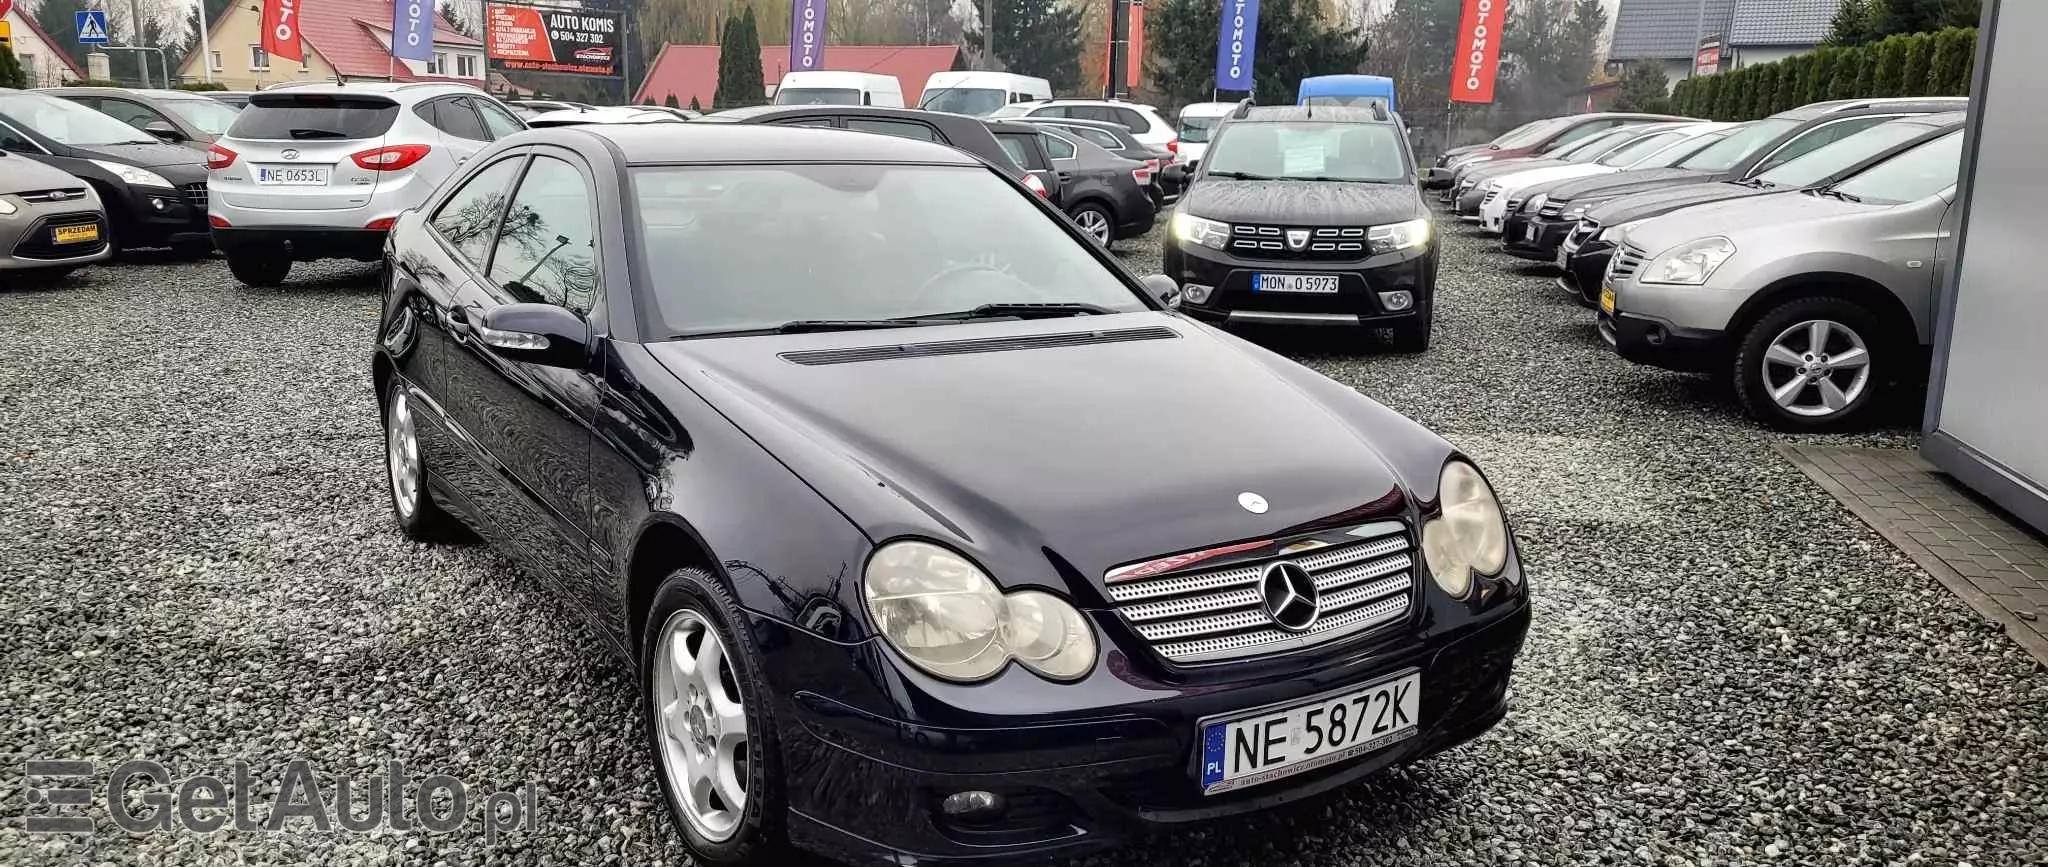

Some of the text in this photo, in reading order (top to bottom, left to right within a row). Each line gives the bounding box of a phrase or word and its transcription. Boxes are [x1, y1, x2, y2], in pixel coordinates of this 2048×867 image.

[407, 0, 421, 46] OTO
[550, 14, 579, 30] AUTO
[581, 17, 614, 33] KOMIS
[560, 31, 604, 44] 504 327 302
[1230, 0, 1248, 79] TOMOTO
[1466, 0, 1491, 90] OTOMOTO
[267, 170, 322, 182] NE 0653L
[57, 225, 96, 235] SPRZEDAM
[1261, 276, 1286, 289] MON
[1306, 277, 1337, 291] 5973
[1234, 681, 1412, 774] NE 5872K
[1206, 762, 1222, 776] PL
